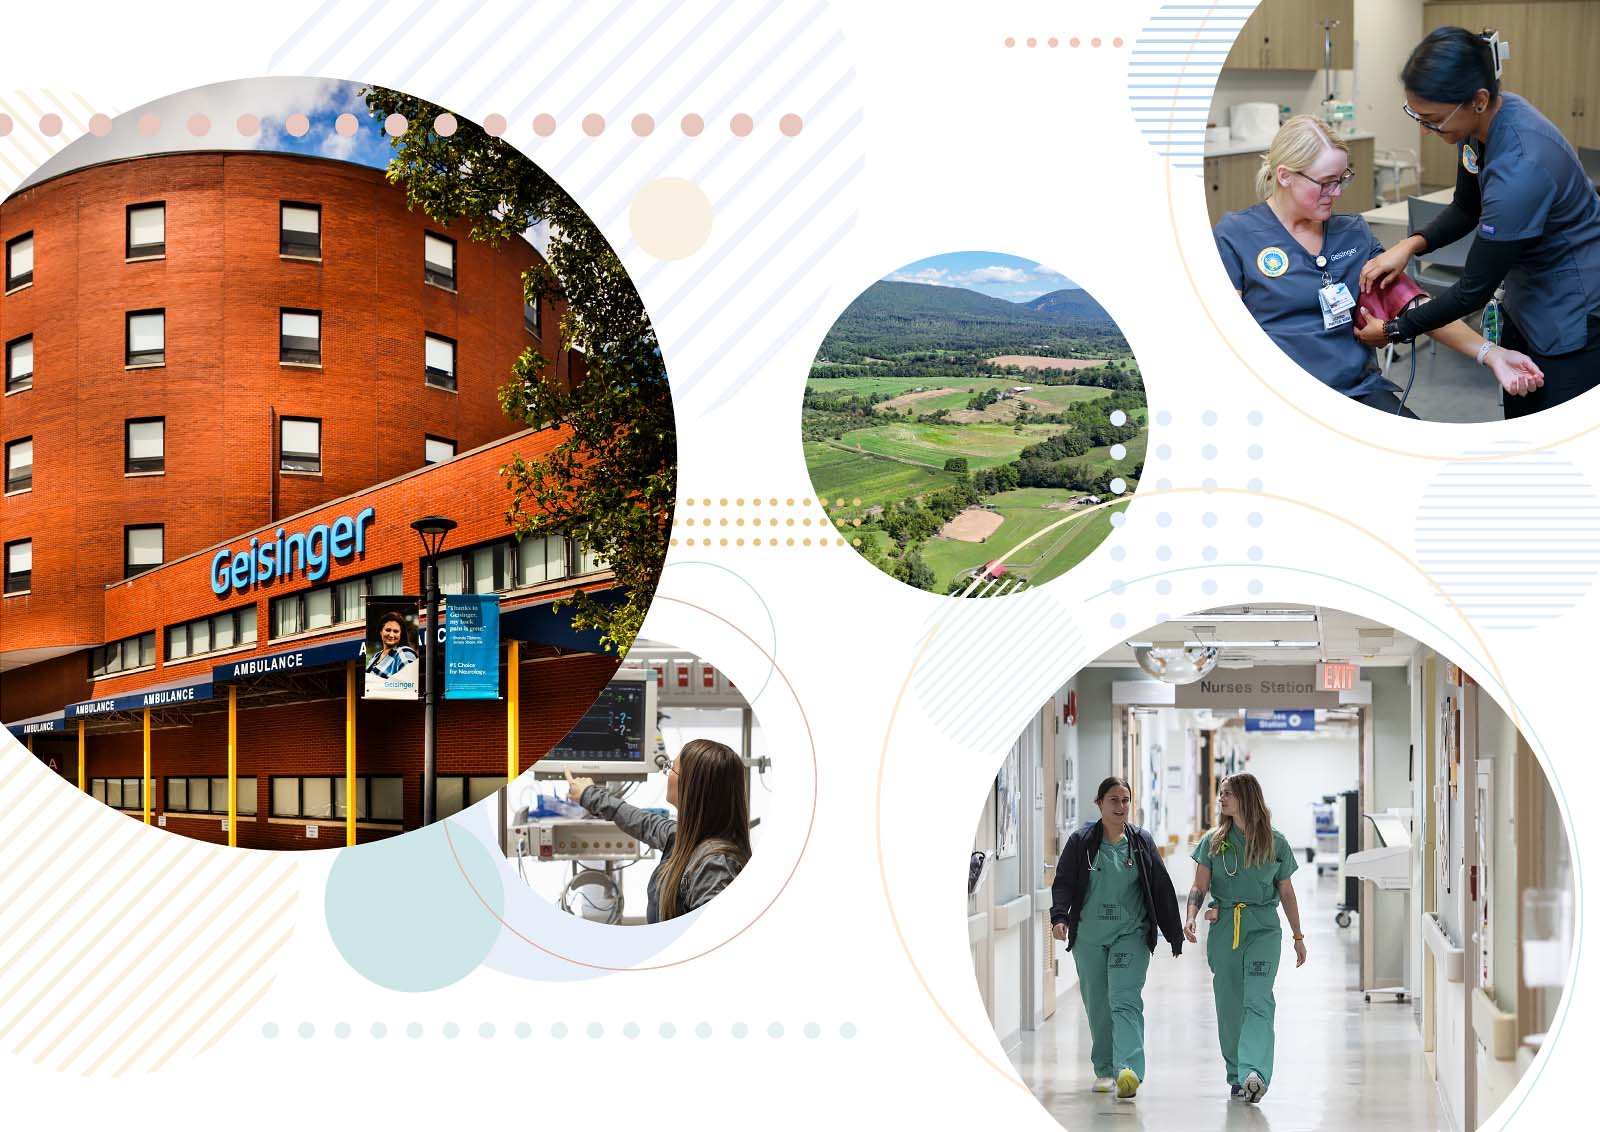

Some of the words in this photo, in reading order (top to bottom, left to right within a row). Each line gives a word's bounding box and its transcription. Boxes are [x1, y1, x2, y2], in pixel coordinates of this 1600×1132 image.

[1331, 247, 1357, 261] Geisinger
[211, 506, 375, 595] Geisinger
[233, 653, 303, 677] AMBULANCE
[1324, 664, 1355, 688] EXIT
[384, 681, 415, 690] Geisinger
[1201, 681, 1252, 693] Nurses
[1260, 680, 1313, 694] Station
[143, 688, 194, 706] AMBULANCE
[75, 700, 115, 715] AMBULANCE
[23, 721, 54, 734] AMBULANCE
